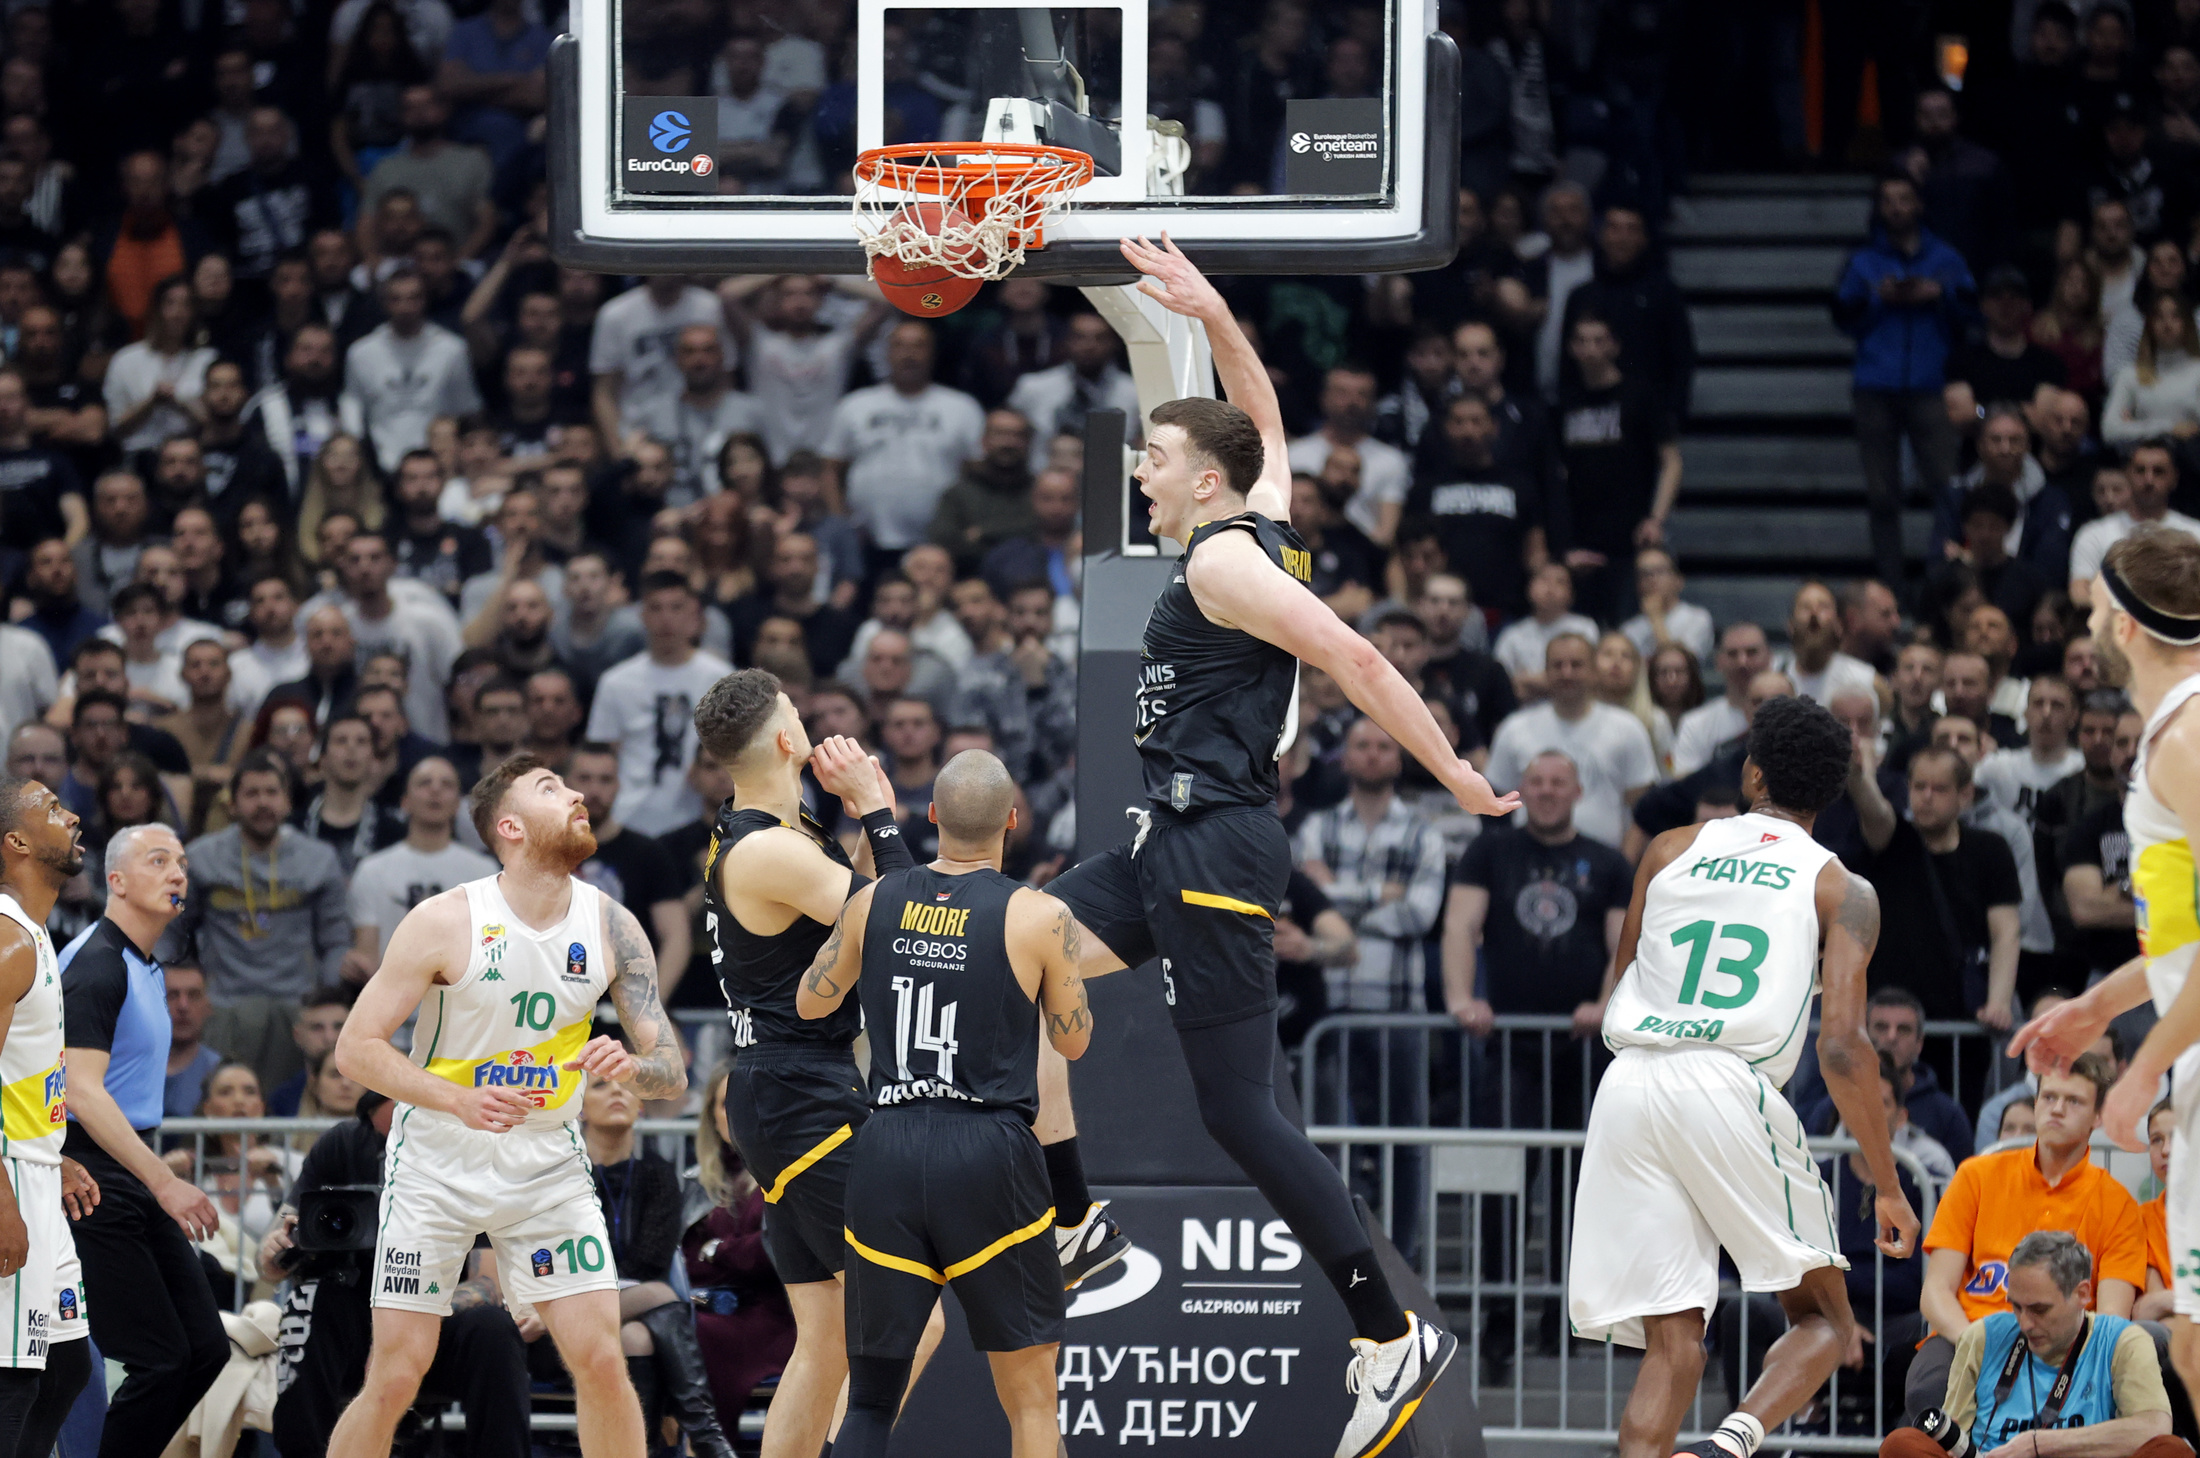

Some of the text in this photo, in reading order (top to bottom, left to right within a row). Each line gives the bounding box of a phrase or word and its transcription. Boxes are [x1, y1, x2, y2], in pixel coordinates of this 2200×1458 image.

[1313, 140, 1377, 152] oneteam
[628, 158, 690, 175] EuroCup
[1145, 664, 1176, 684] NIS
[1690, 856, 1797, 890] HAYES
[900, 900, 971, 938] MOORE
[892, 937, 968, 960] GLOBOS
[909, 958, 966, 972] OSIGURANJE
[1670, 919, 1770, 1009] 13
[510, 990, 556, 1031] 10
[891, 975, 959, 1085] 14
[385, 1247, 422, 1267] Kent
[555, 1235, 605, 1274] 10
[1181, 1218, 1303, 1272] NIS
[383, 1276, 420, 1295] AVM
[1181, 1299, 1302, 1315] GAZPROM NEFT
[1057, 1345, 1300, 1392] ДУЋНОСТ
[2053, 1373, 2069, 1399] EOS
[1119, 1399, 1258, 1446] ДЕЛУ
